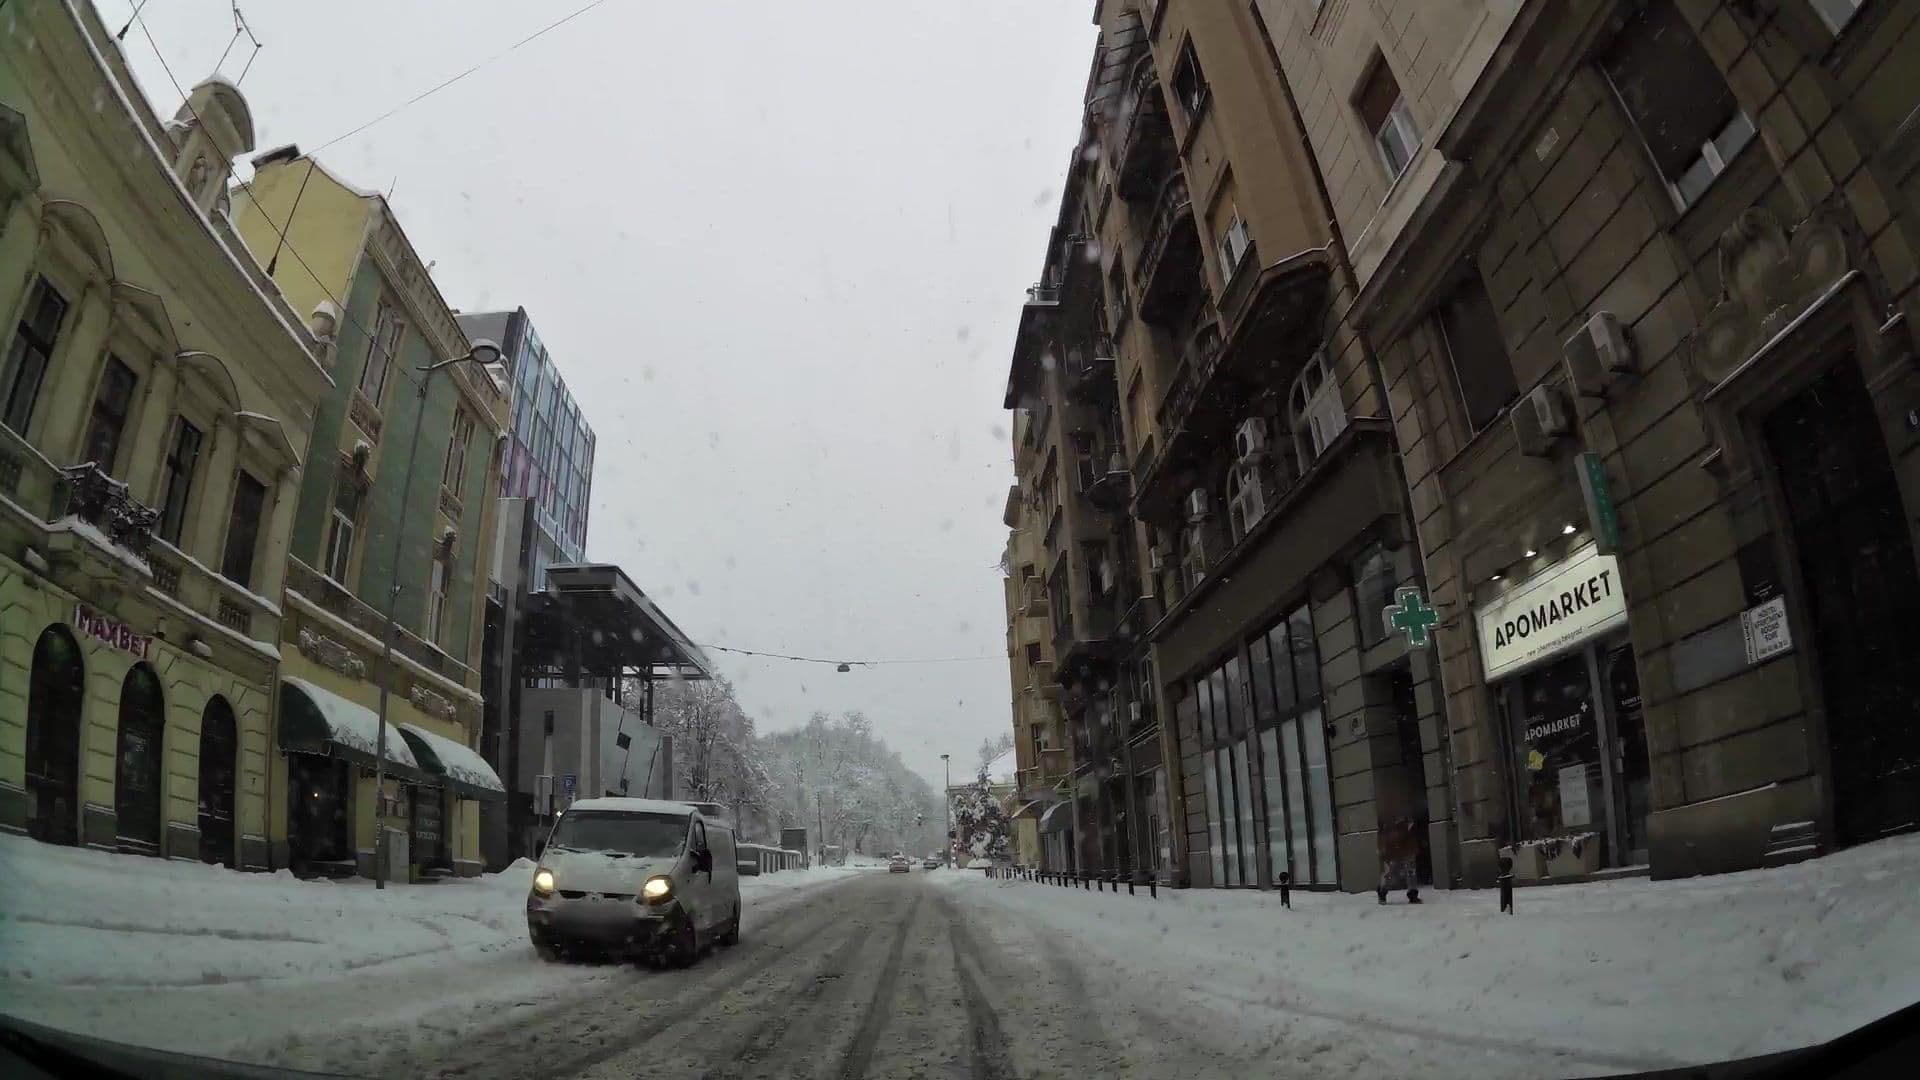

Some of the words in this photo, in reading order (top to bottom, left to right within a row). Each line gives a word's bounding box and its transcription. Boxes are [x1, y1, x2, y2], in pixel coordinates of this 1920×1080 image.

[74, 602, 153, 659] MAXBET
[1495, 569, 1610, 650] APOMARKET
[1524, 713, 1581, 742] APOMARKET
